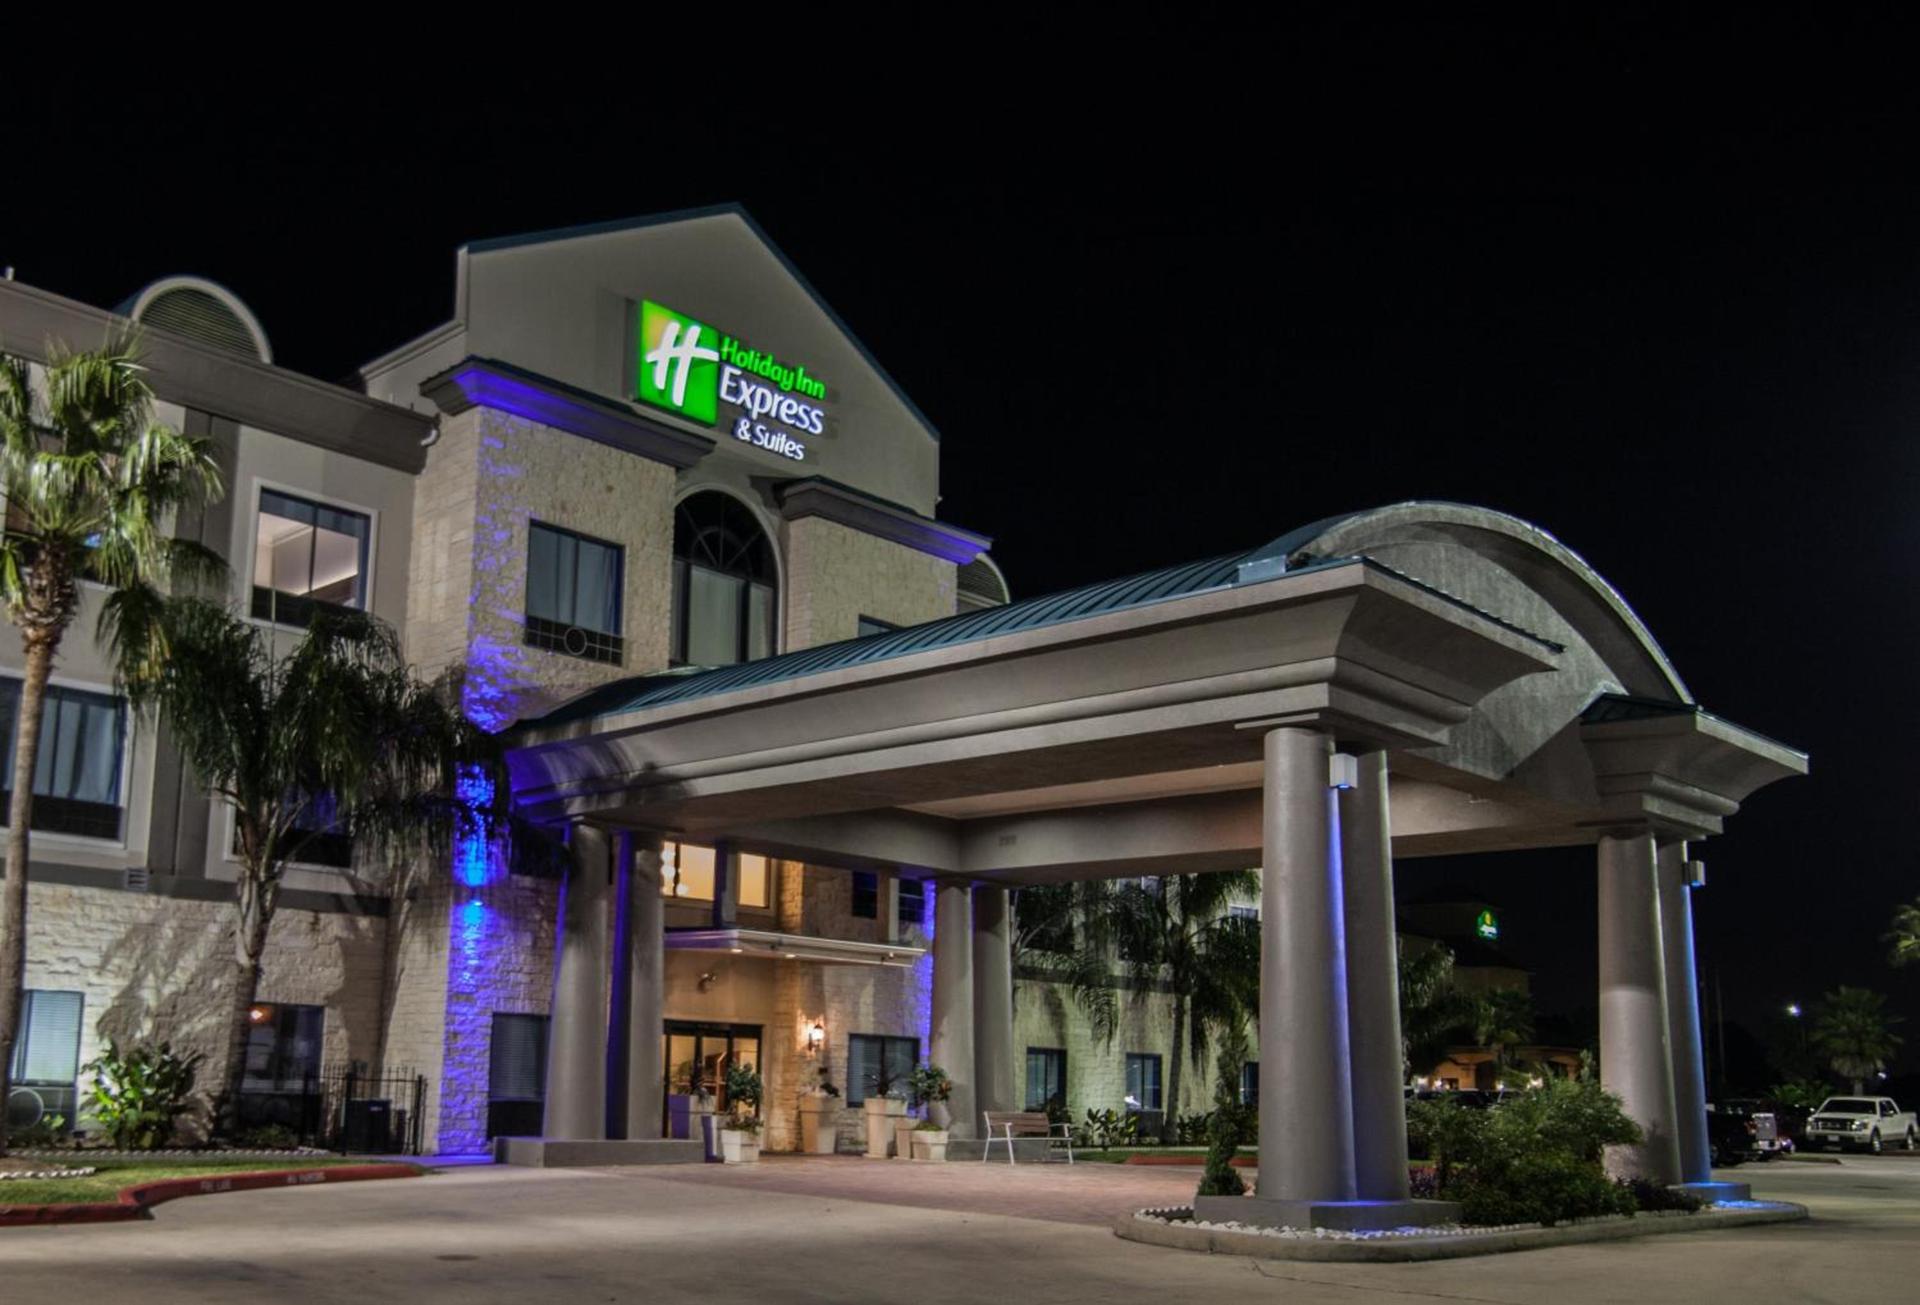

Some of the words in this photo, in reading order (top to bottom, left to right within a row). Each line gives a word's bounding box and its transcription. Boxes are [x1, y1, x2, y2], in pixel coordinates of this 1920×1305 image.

[719, 365, 824, 435] Express
[721, 336, 793, 391] Holiday
[794, 366, 825, 400] Inn
[737, 418, 751, 441] &
[753, 424, 805, 461] Suites
